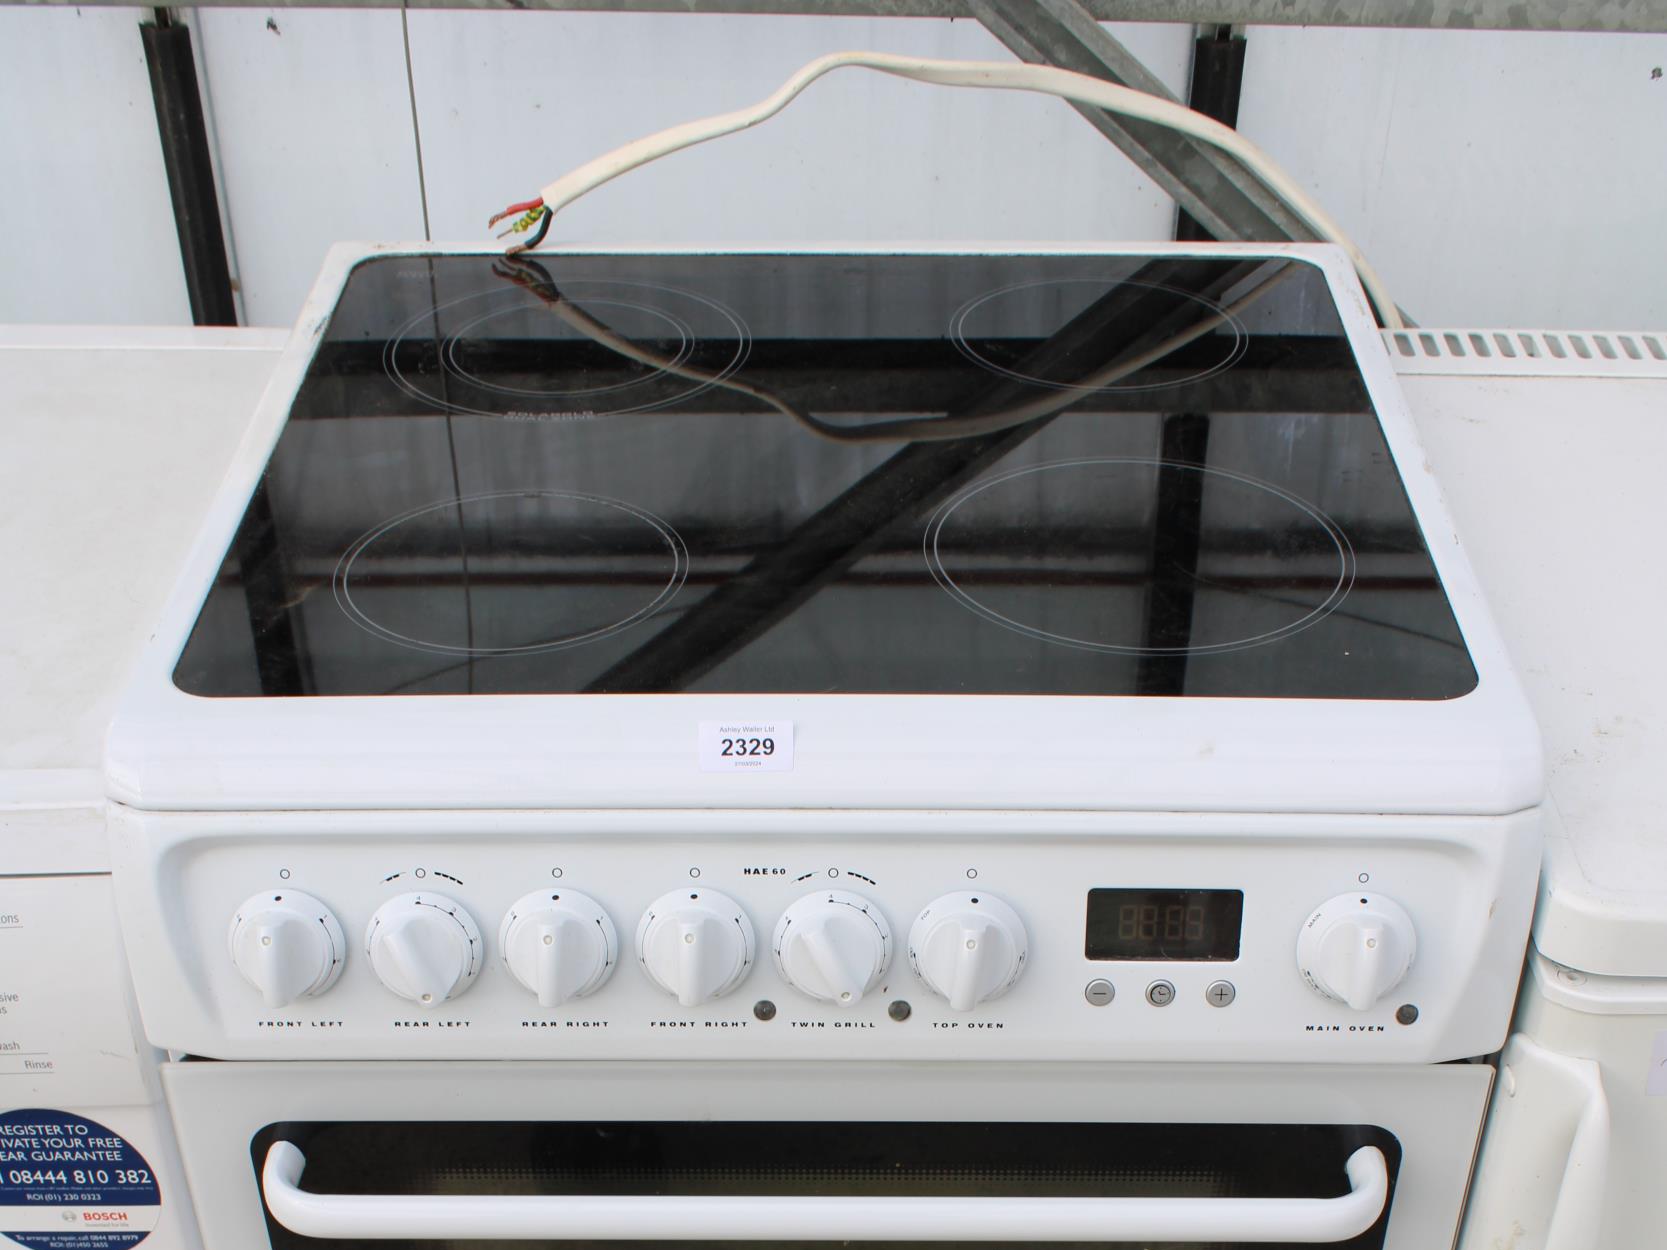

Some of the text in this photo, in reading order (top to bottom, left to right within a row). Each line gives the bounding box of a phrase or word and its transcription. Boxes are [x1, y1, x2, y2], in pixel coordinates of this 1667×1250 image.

[721, 738, 775, 756] 2329
[0, 914, 19, 924] ons
[0, 992, 19, 1002] sive
[24, 1060, 53, 1069] Rinse
[0, 1124, 89, 1136] REGISTER TO
[1, 1137, 123, 1149] IVATE YOUR FREE
[0, 1150, 123, 1162] EAR GUARANTEE
[9, 1169, 68, 1184] 08444
[73, 1169, 109, 1184] 810
[116, 1169, 152, 1184] 382
[64, 1193, 79, 1201] 230
[80, 1193, 102, 1201] 0323
[83, 1212, 128, 1221] BOSCH
